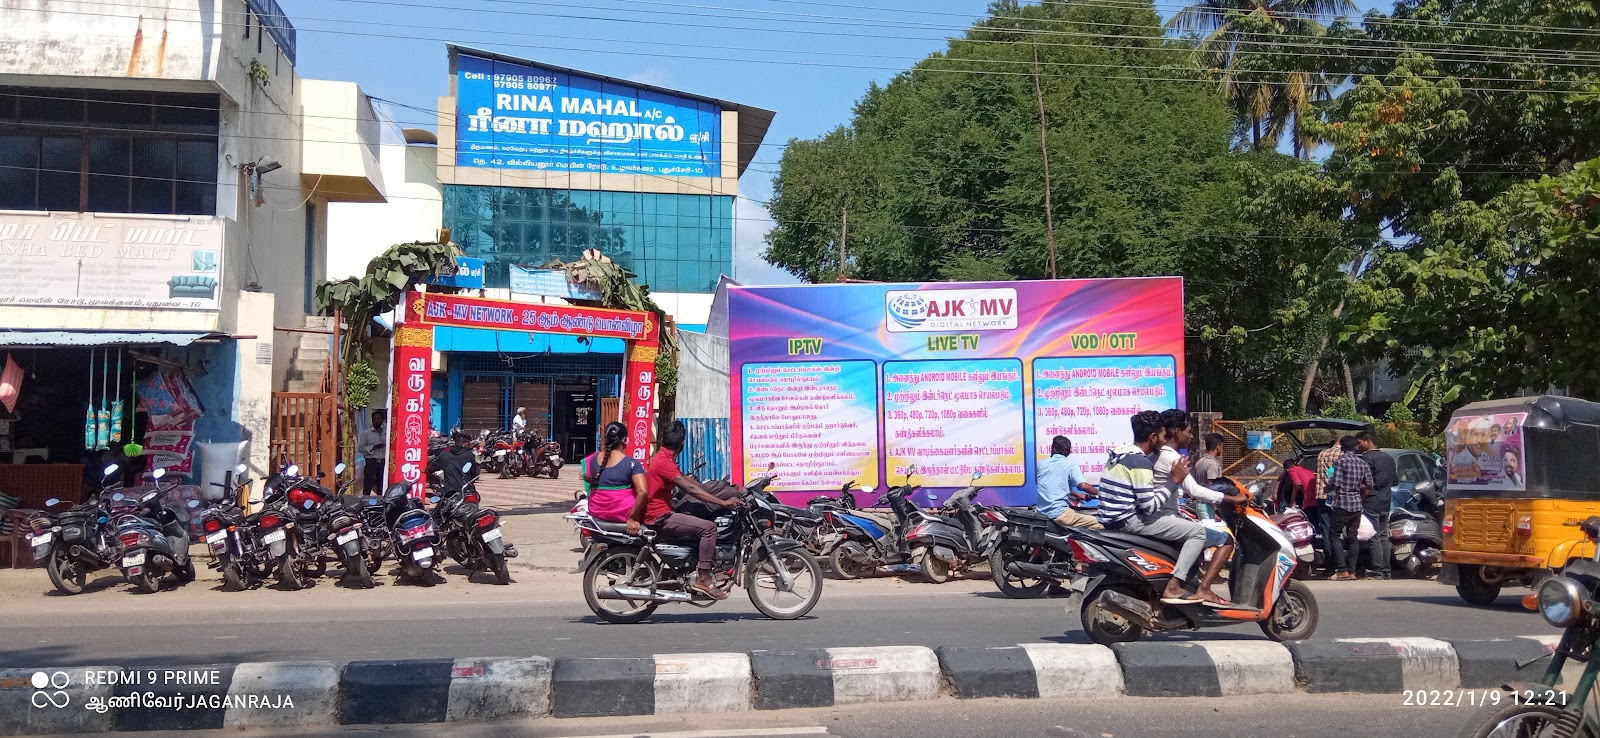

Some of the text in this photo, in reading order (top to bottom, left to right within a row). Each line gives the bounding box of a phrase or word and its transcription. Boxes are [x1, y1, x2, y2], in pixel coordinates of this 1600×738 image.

[465, 72, 484, 80] Cell
[494, 74, 524, 82] 97905
[494, 81, 524, 89] 97905
[496, 93, 662, 121] RINA MAHAL A/C
[468, 106, 552, 135] ரீனா
[557, 116, 685, 145] மஹால்
[49, 220, 115, 243] பெட்
[123, 224, 209, 246] மார்ட்
[60, 244, 102, 258] BED
[113, 245, 177, 261] MART
[927, 298, 1013, 317] AJK MV
[426, 301, 447, 318] AJK
[453, 304, 468, 320] MV
[469, 305, 514, 323] NETWORK
[522, 310, 536, 325] 25
[538, 311, 559, 329] ஆம்
[560, 313, 594, 333] ஆண்டு
[595, 316, 643, 338] பொன்விழா
[788, 338, 823, 355] IPTV
[927, 334, 979, 351] LIVE TV
[1070, 333, 1099, 350] VOD
[1108, 332, 1137, 350] OTT
[920, 372, 945, 382] ANDROID
[945, 372, 967, 382] MOBILE
[1071, 369, 1097, 379] ANDROID
[1098, 368, 1120, 378] MOBILE
